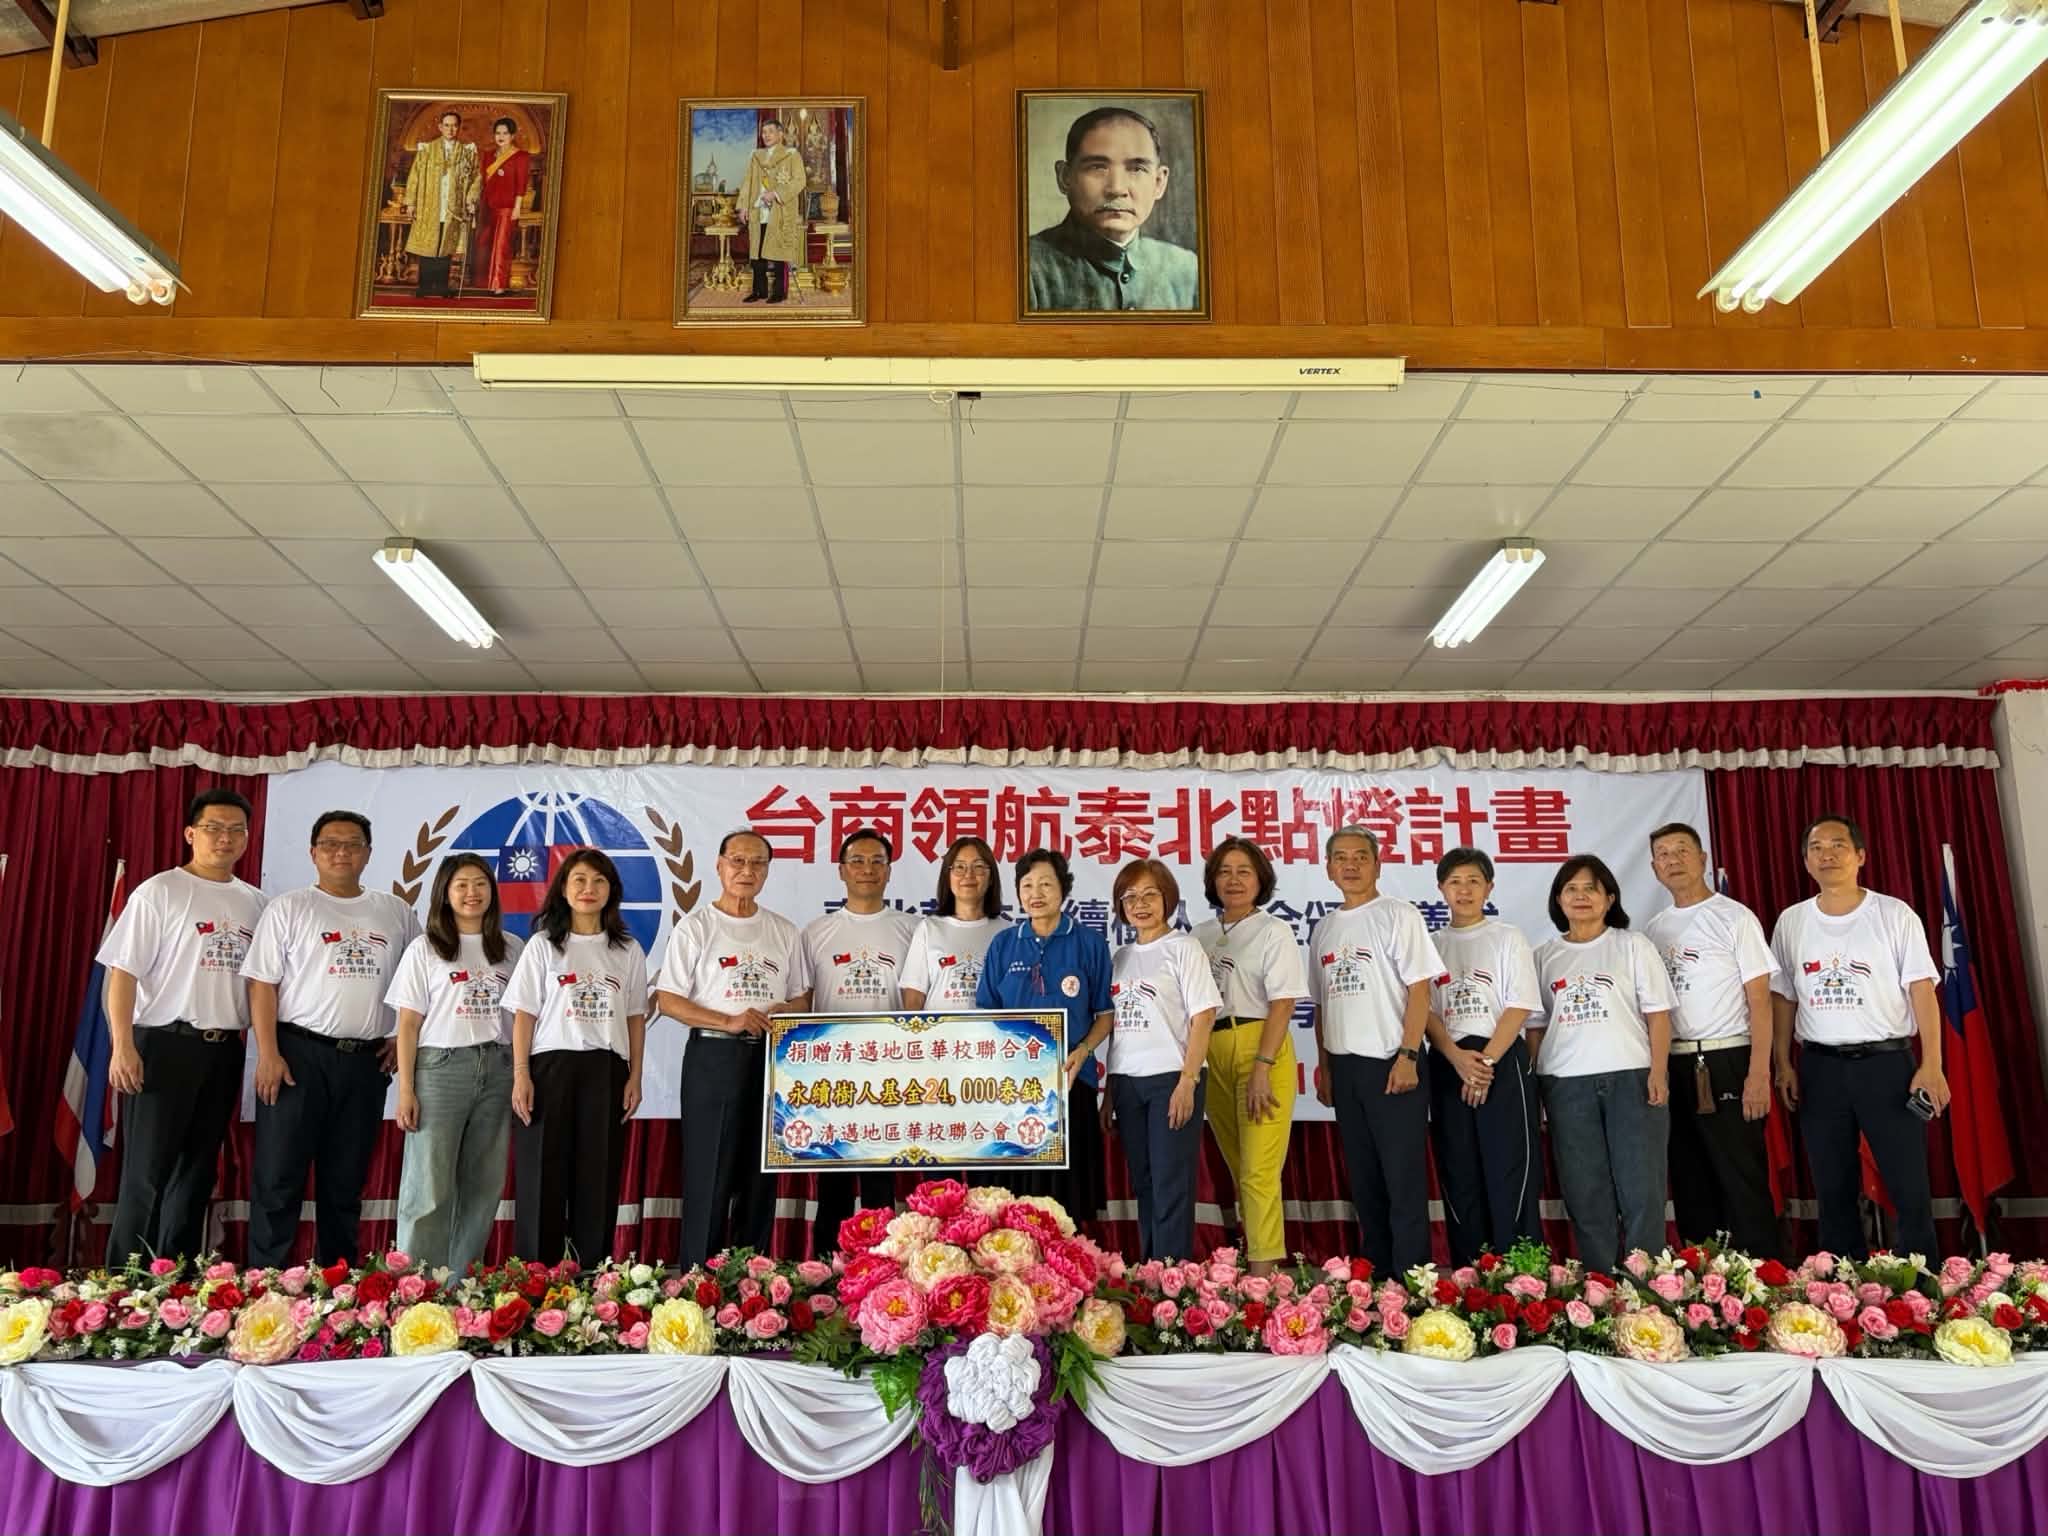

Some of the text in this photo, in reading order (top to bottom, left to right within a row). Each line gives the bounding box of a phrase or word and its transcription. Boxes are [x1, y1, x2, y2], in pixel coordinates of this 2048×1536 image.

[1299, 367, 1341, 375] VERTEX
[788, 1039, 1043, 1063] 捐贈清邁地區華校聯合會
[820, 1121, 1010, 1143] 清邁地區華校聯合會
